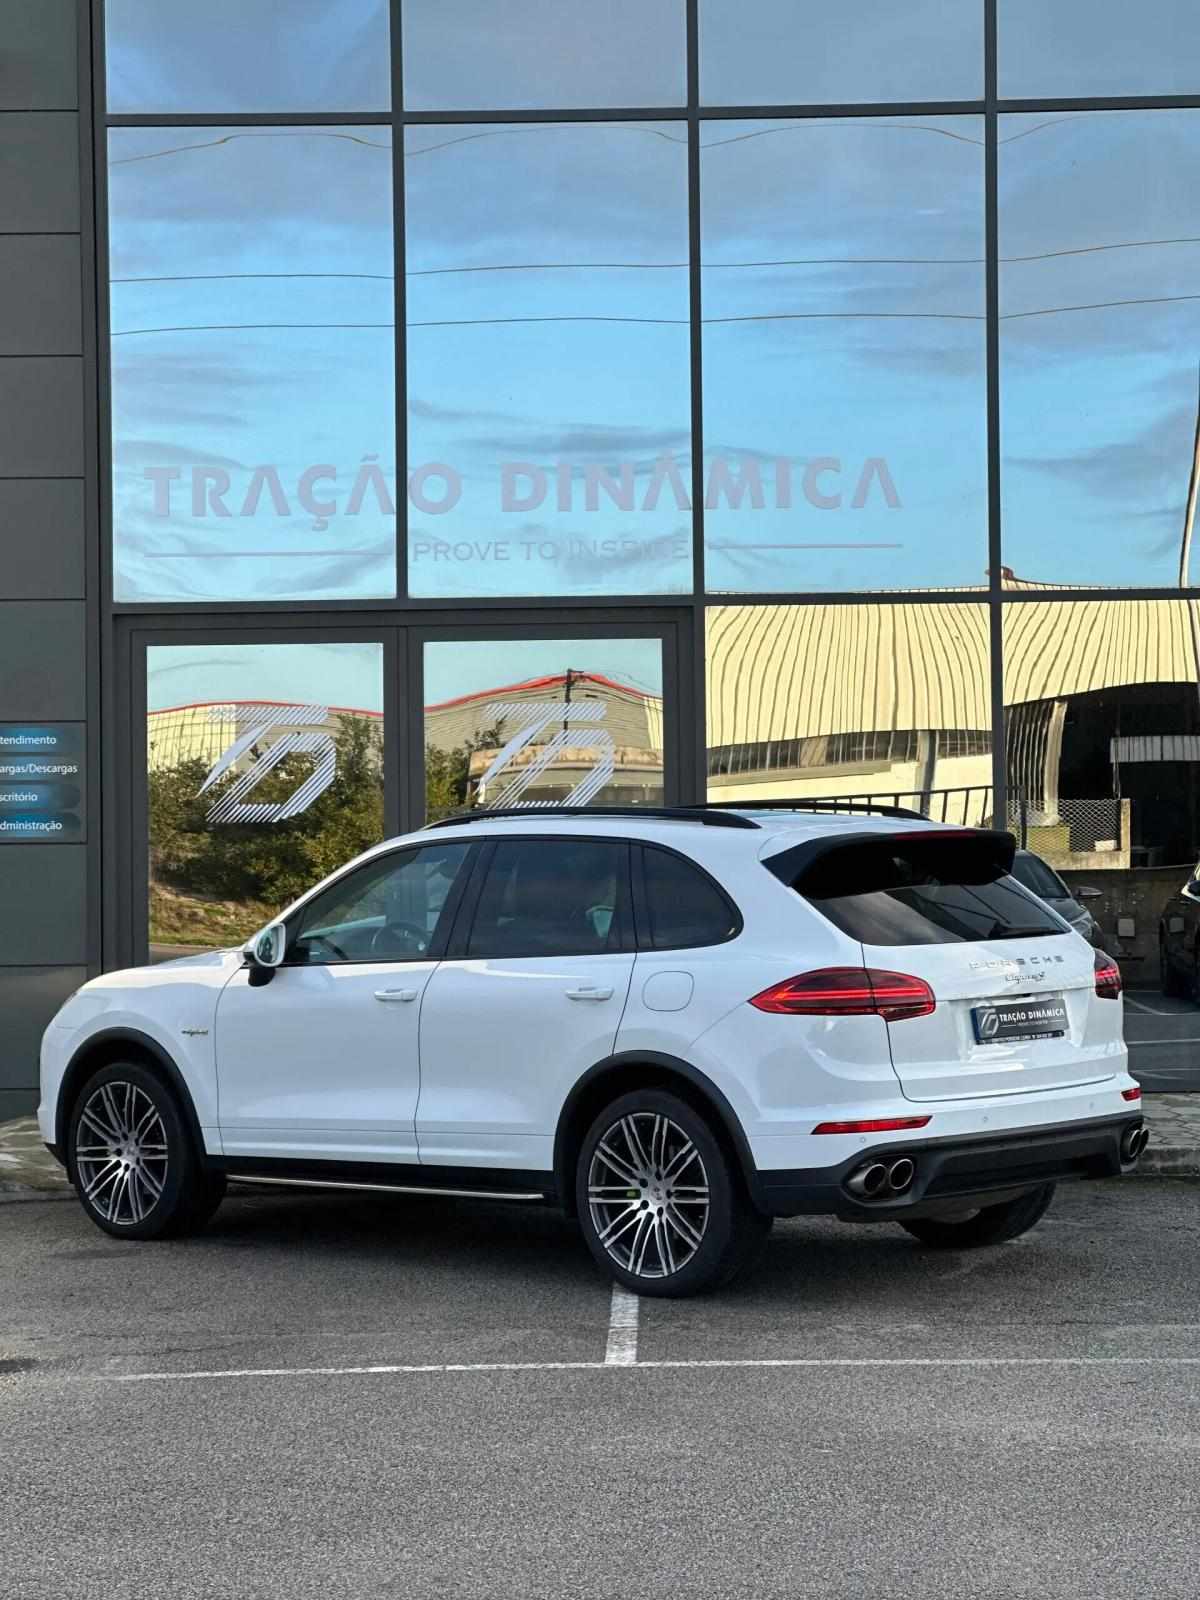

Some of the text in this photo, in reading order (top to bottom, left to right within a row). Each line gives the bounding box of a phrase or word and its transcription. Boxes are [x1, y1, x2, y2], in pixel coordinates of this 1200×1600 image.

[144, 450, 903, 531] TRAÇÃO DINÂMICA
[413, 541, 510, 562] PROVE
[520, 541, 559, 561] TO
